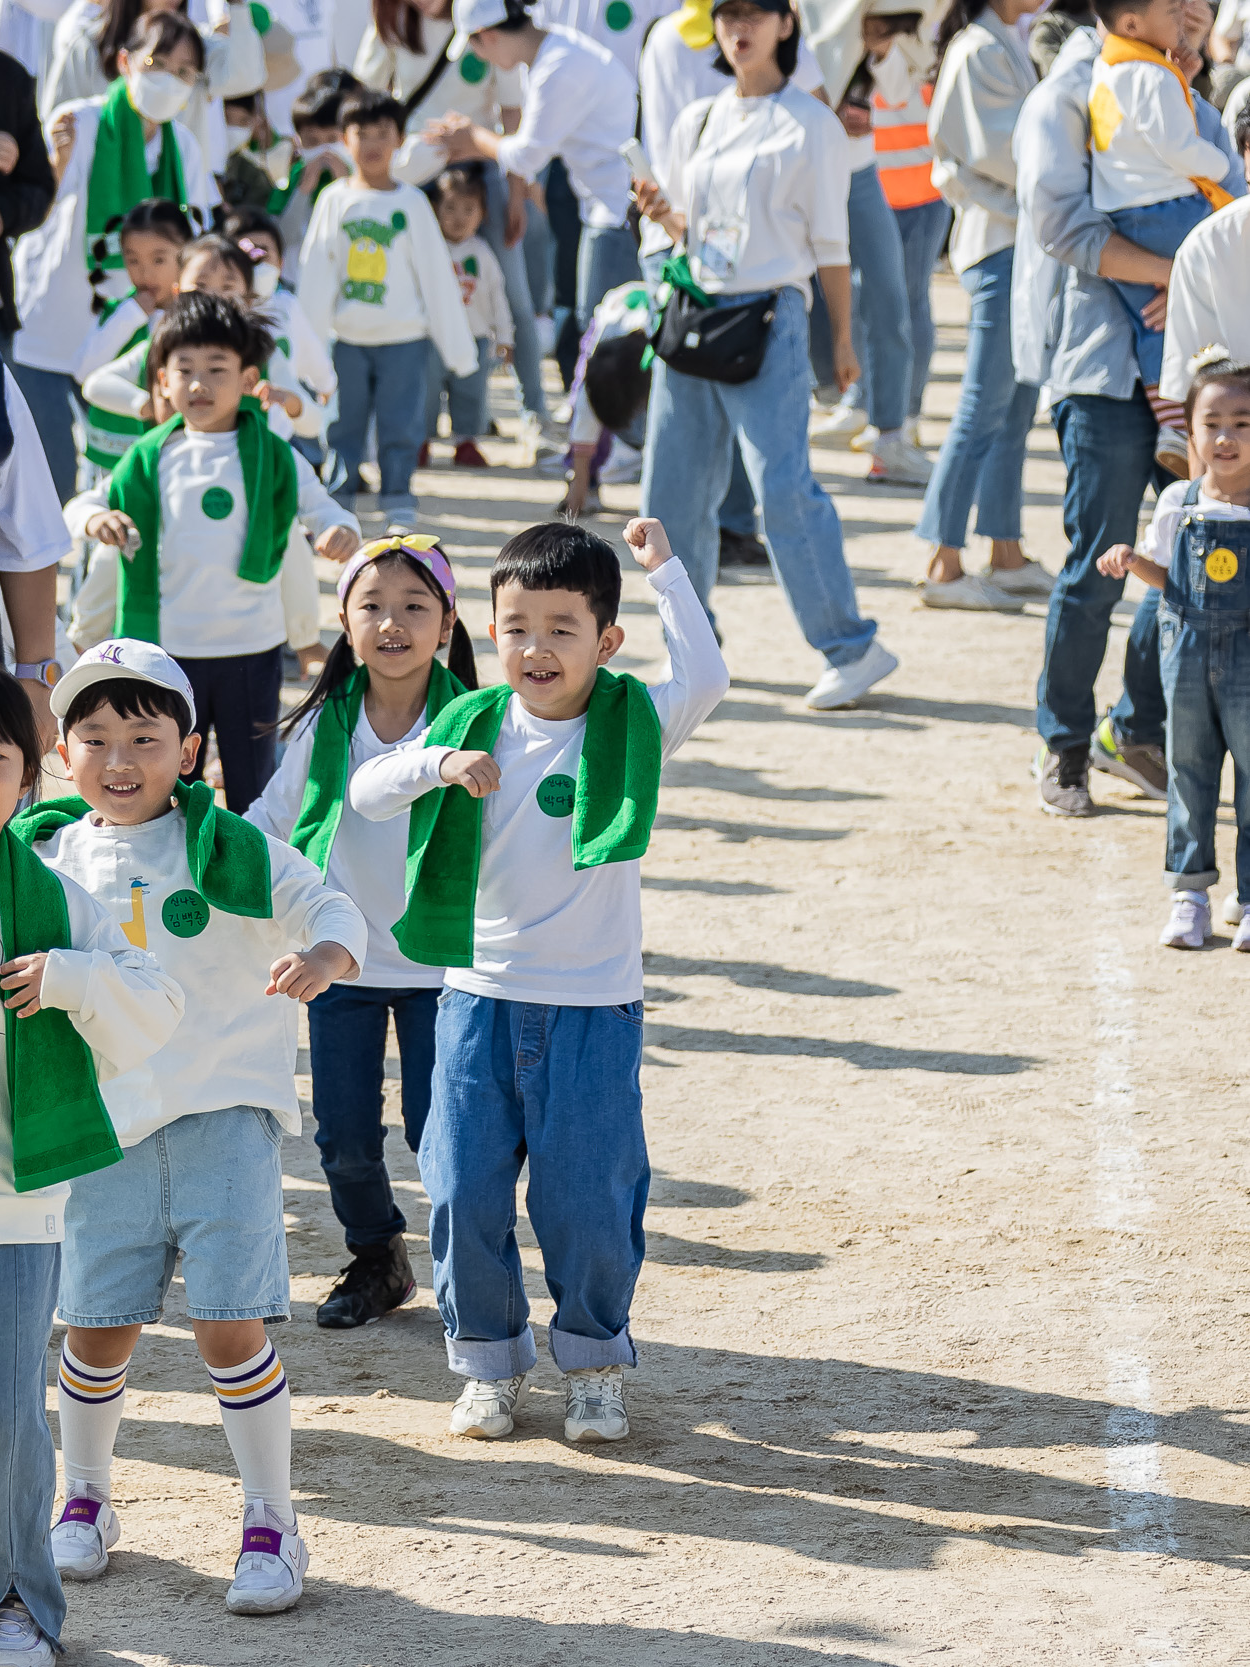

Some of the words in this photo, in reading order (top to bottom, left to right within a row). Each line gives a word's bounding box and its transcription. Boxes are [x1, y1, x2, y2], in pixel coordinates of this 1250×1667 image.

[547, 779, 571, 789] 신나는
[170, 896, 198, 907] 신나는
[167, 910, 206, 928] 김백준
